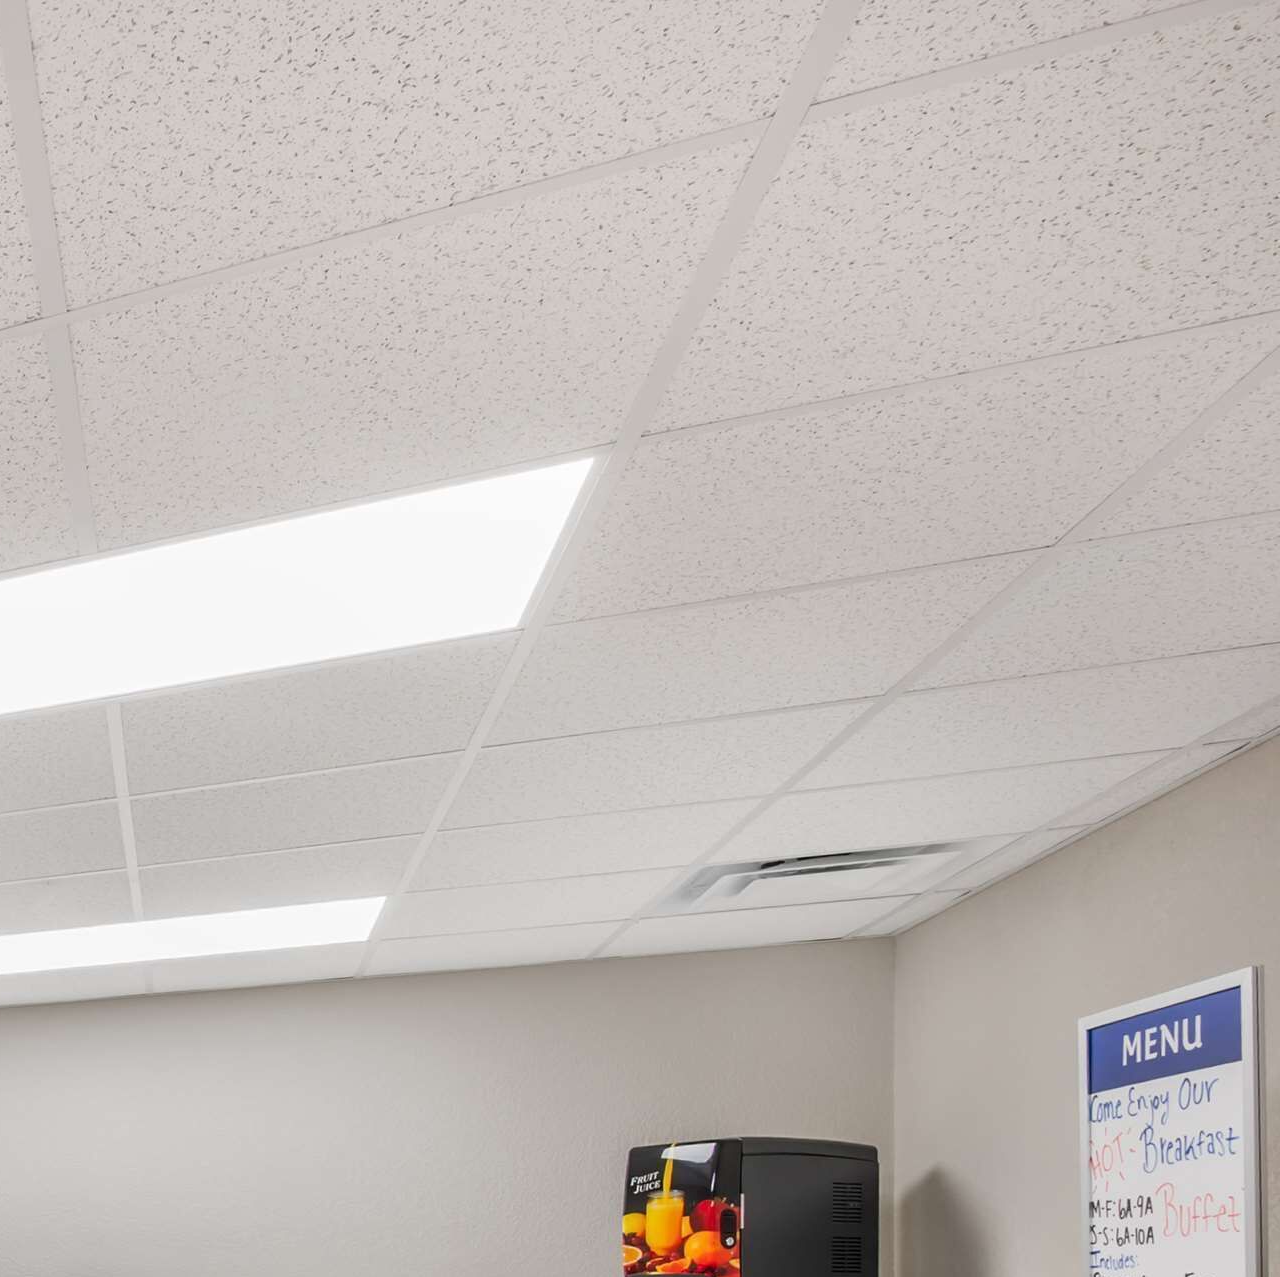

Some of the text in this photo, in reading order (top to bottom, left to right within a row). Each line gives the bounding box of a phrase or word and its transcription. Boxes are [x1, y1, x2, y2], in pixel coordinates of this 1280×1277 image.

[1122, 1014, 1202, 1066] MENU
[1089, 1078, 1219, 1127] Come Enjoy Our
[1139, 1126, 1240, 1174] Breakfast
[630, 1171, 660, 1187] FRUIT
[633, 1180, 661, 1195] JUICE
[1155, 1182, 1241, 1237] Buffet
